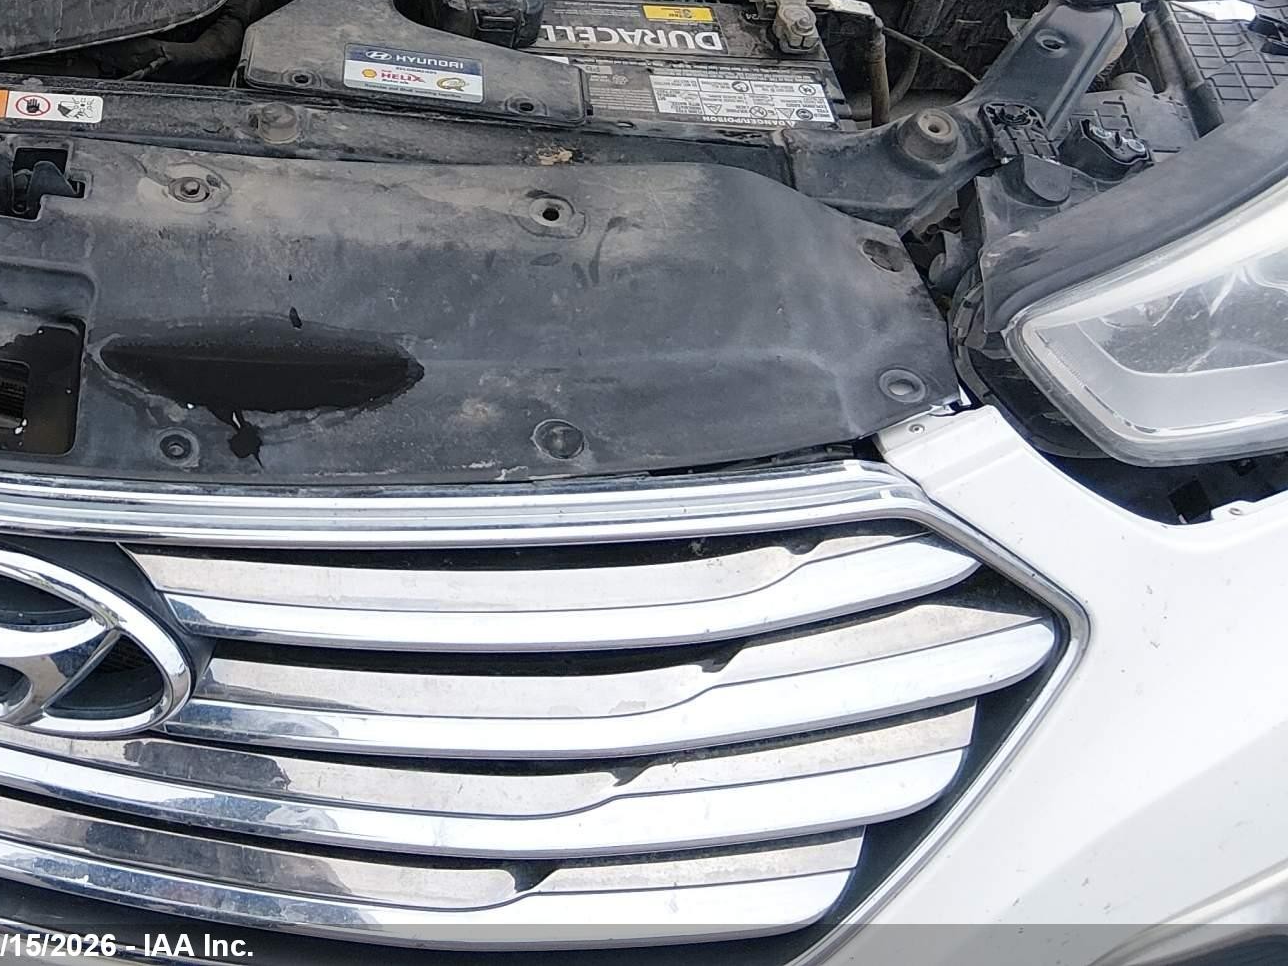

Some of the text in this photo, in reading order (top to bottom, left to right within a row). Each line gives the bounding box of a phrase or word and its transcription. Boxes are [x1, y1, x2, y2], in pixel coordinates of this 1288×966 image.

[541, 25, 723, 51] DURACELL
[395, 54, 464, 70] HYUNDAI
[381, 72, 426, 83] HELIX
